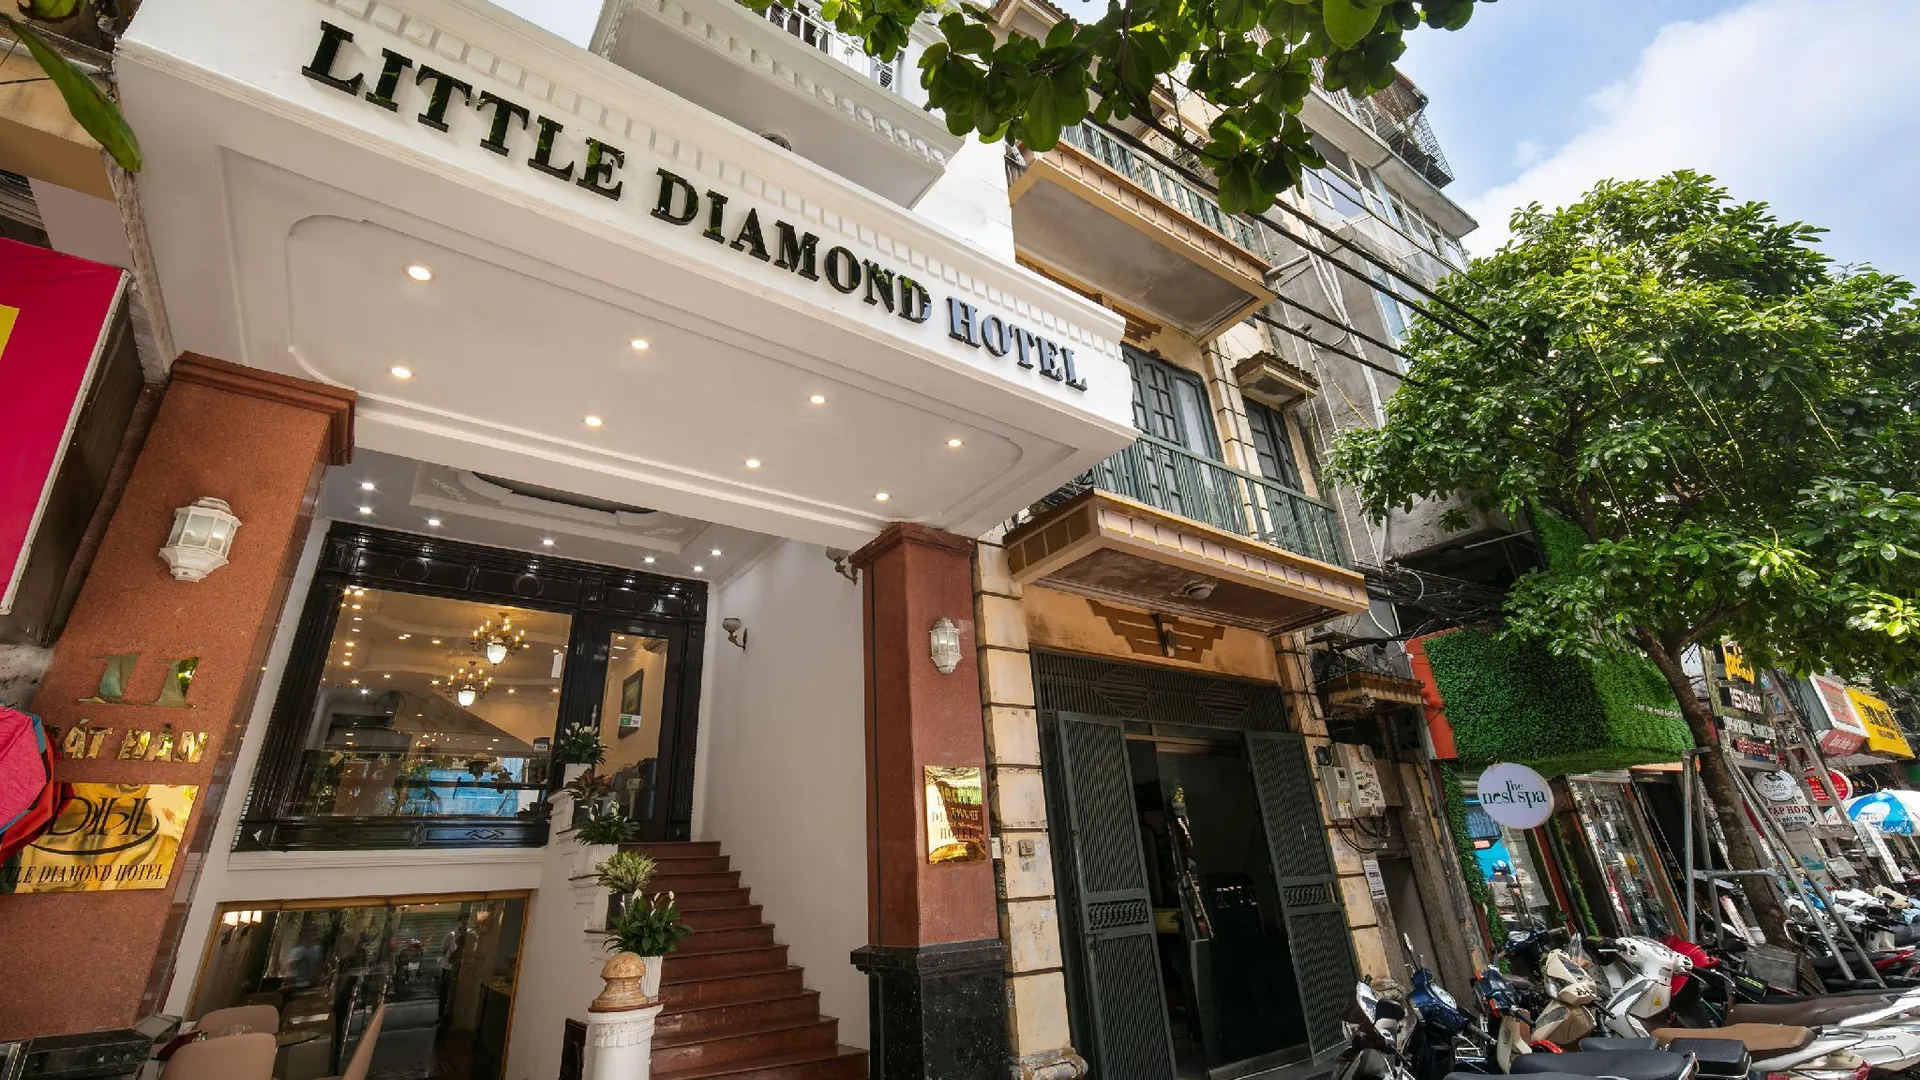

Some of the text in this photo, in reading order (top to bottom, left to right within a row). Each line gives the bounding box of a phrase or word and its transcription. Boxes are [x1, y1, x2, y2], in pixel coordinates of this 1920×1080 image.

[302, 20, 1087, 391] LITTLE DIAMOND HOTEL
[45, 719, 113, 760] ÁT
[1517, 790, 1548, 809] spa
[38, 864, 112, 884] DIAMOND
[114, 863, 164, 882] HOTEL
